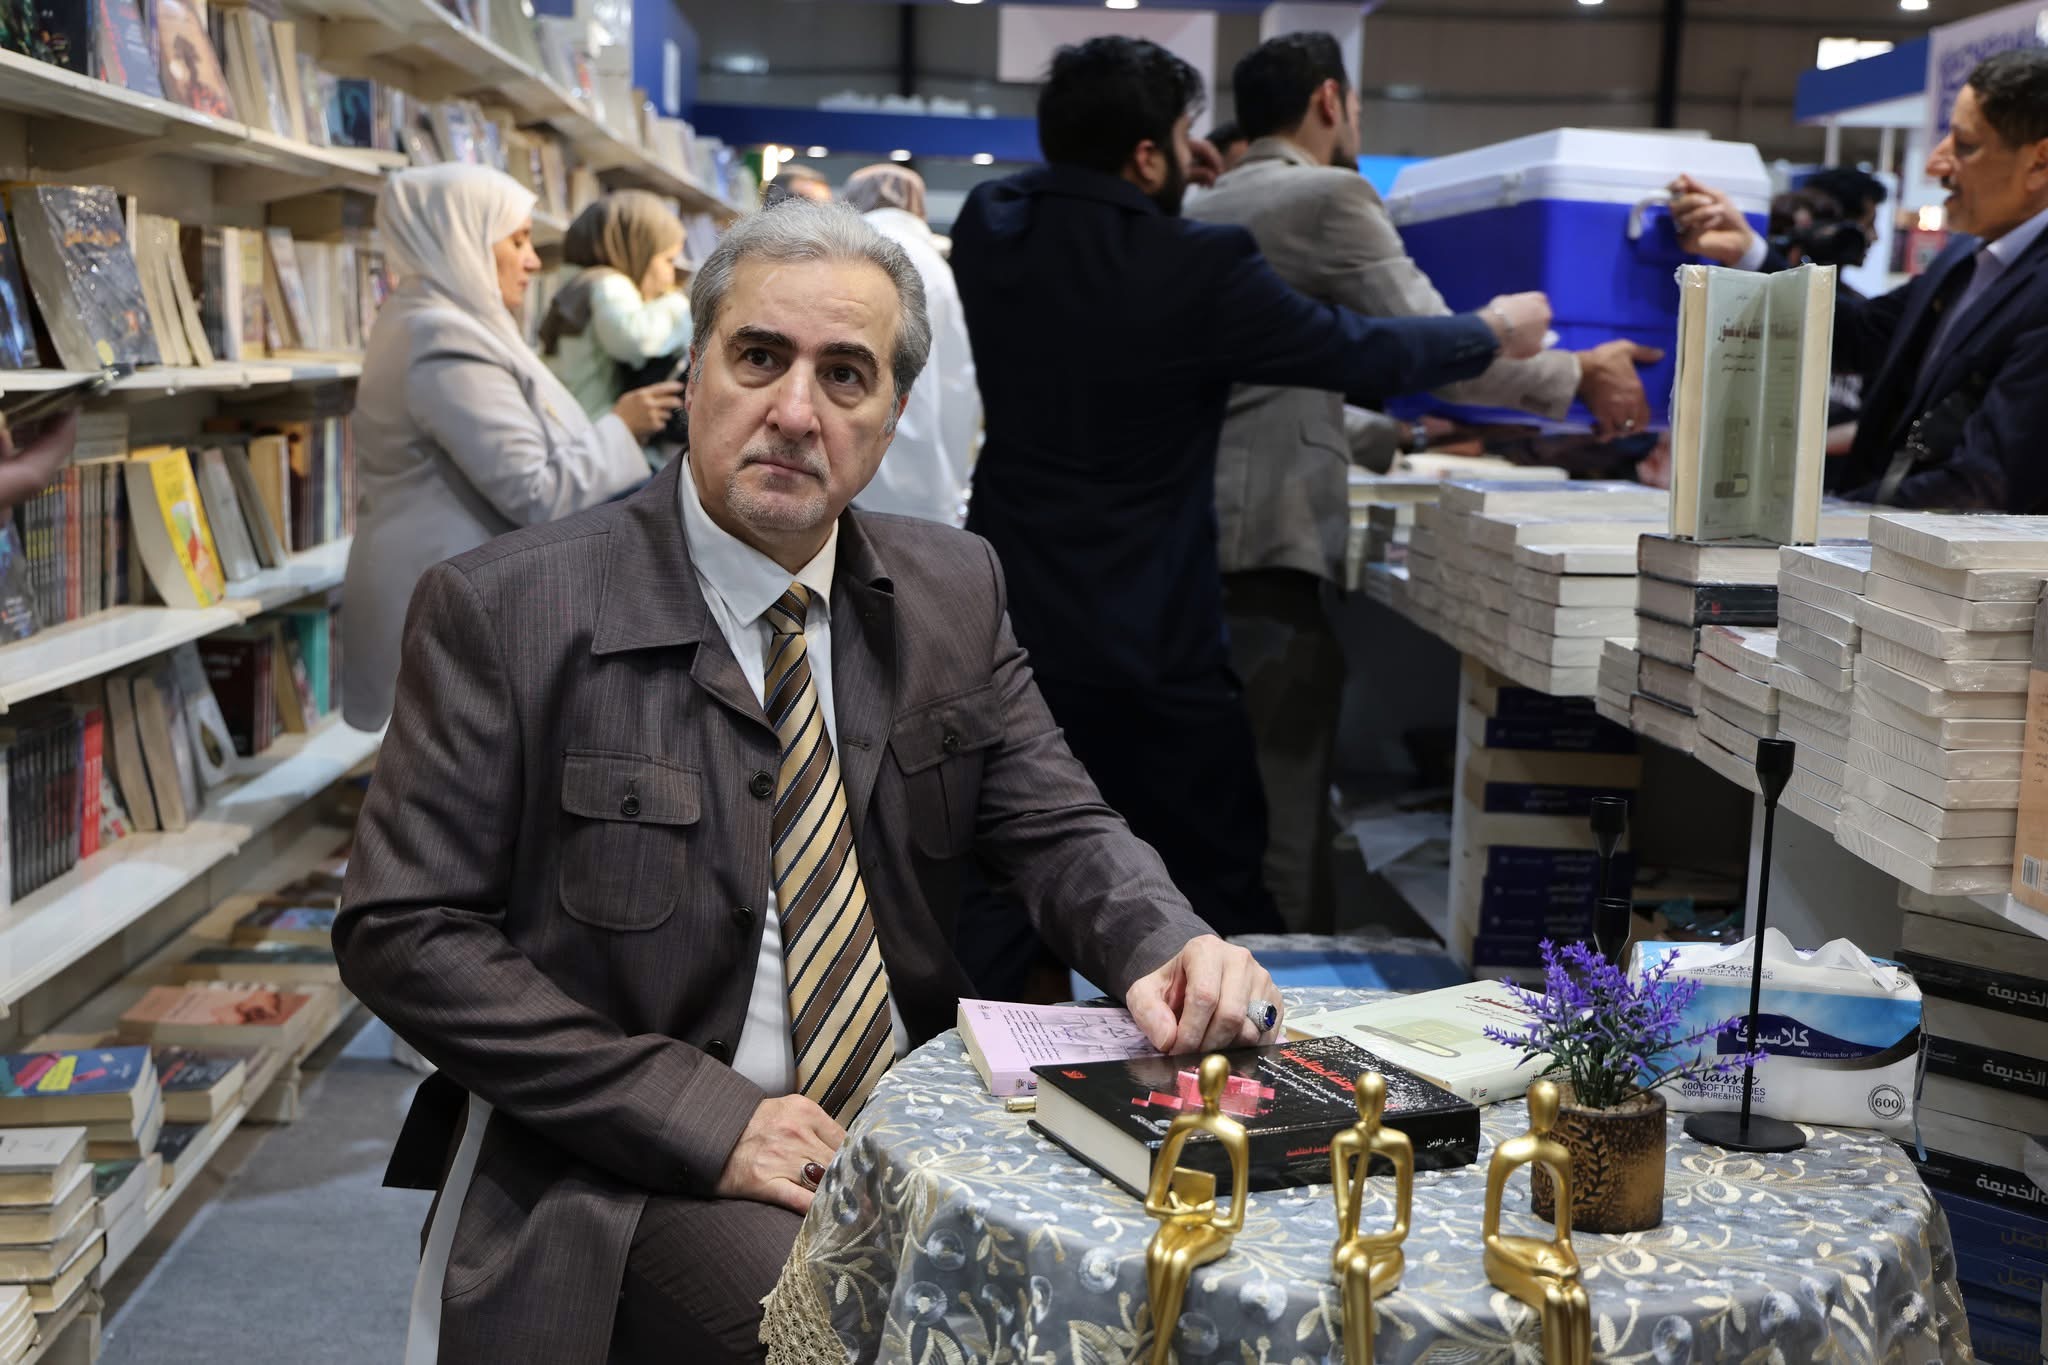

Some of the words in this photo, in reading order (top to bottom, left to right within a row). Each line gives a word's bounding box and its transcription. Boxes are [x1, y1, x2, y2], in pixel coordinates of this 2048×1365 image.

[1800, 1050, 1821, 1058] Always
[1983, 1060, 2046, 1087] الخديعة
[1682, 1082, 1699, 1090] 600
[1700, 1083, 1725, 1093] SOFT
[1875, 1098, 1899, 1109] 600
[1426, 1138, 1444, 1149] المؤمن
[1976, 1174, 2039, 1202] الخديعة
